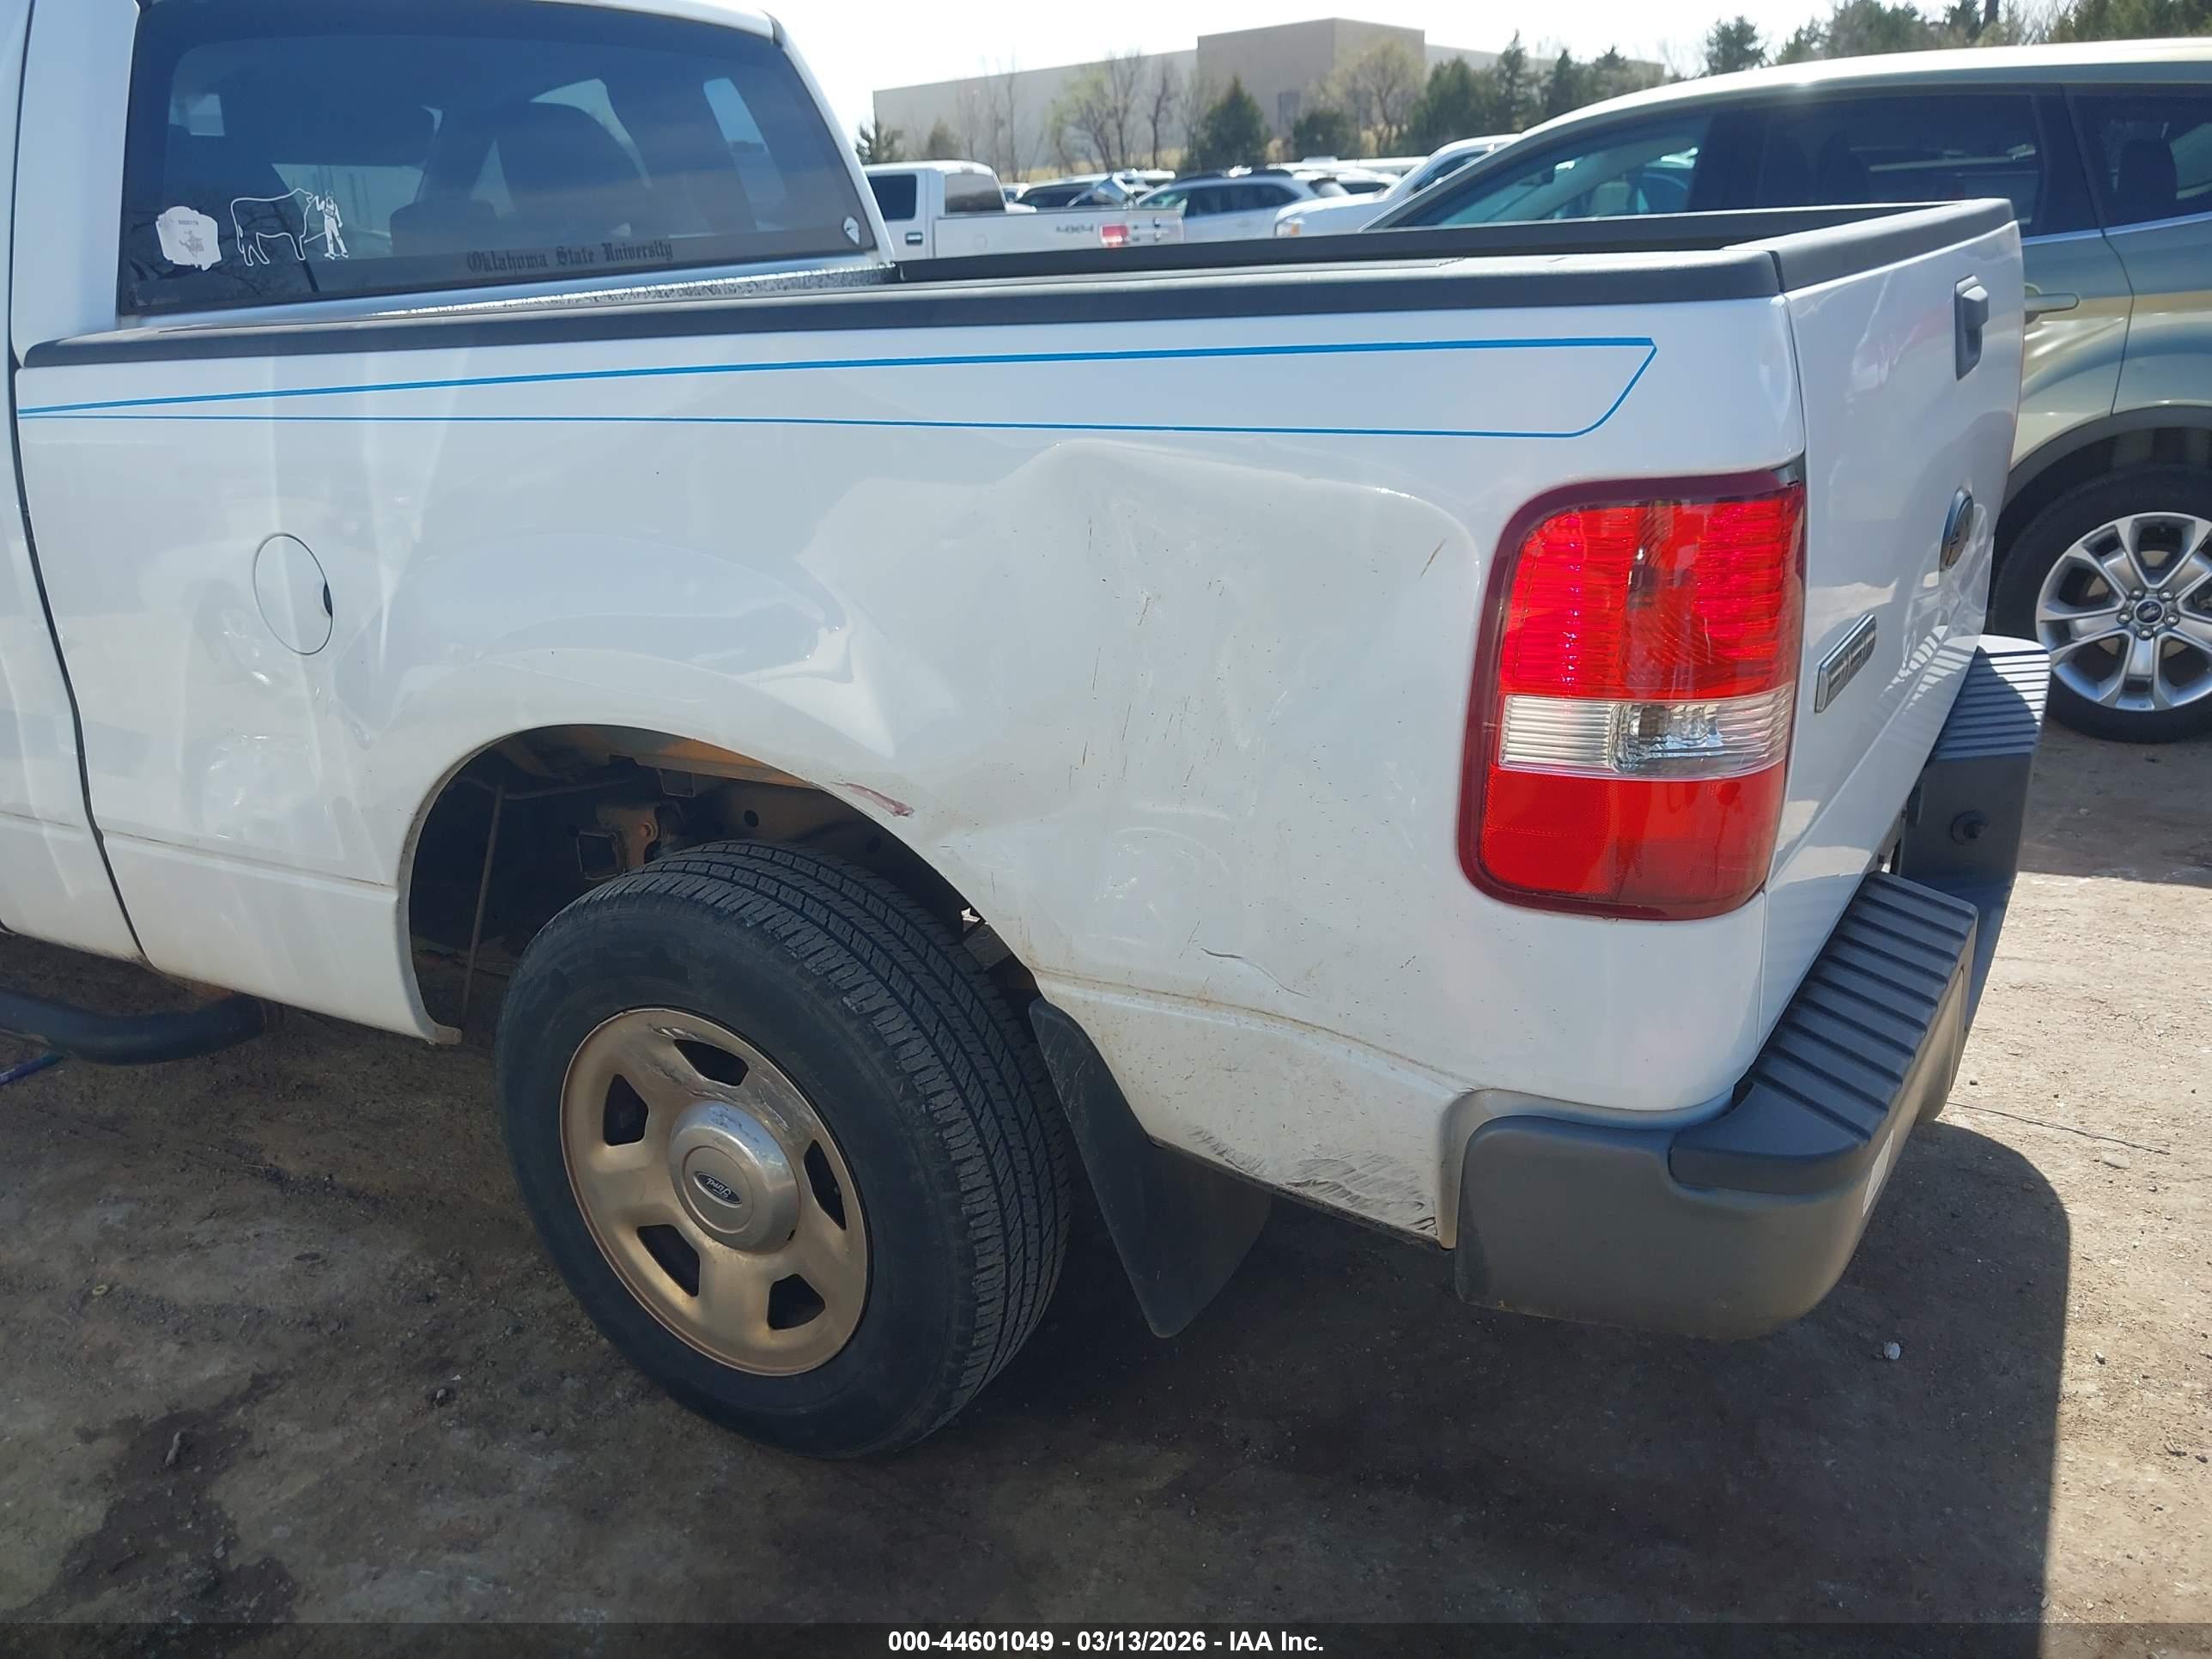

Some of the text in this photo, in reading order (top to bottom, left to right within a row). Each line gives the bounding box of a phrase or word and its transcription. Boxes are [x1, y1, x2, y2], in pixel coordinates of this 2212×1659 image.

[467, 240, 673, 274] Oklahoma State University
[706, 1177, 732, 1199] Ford
